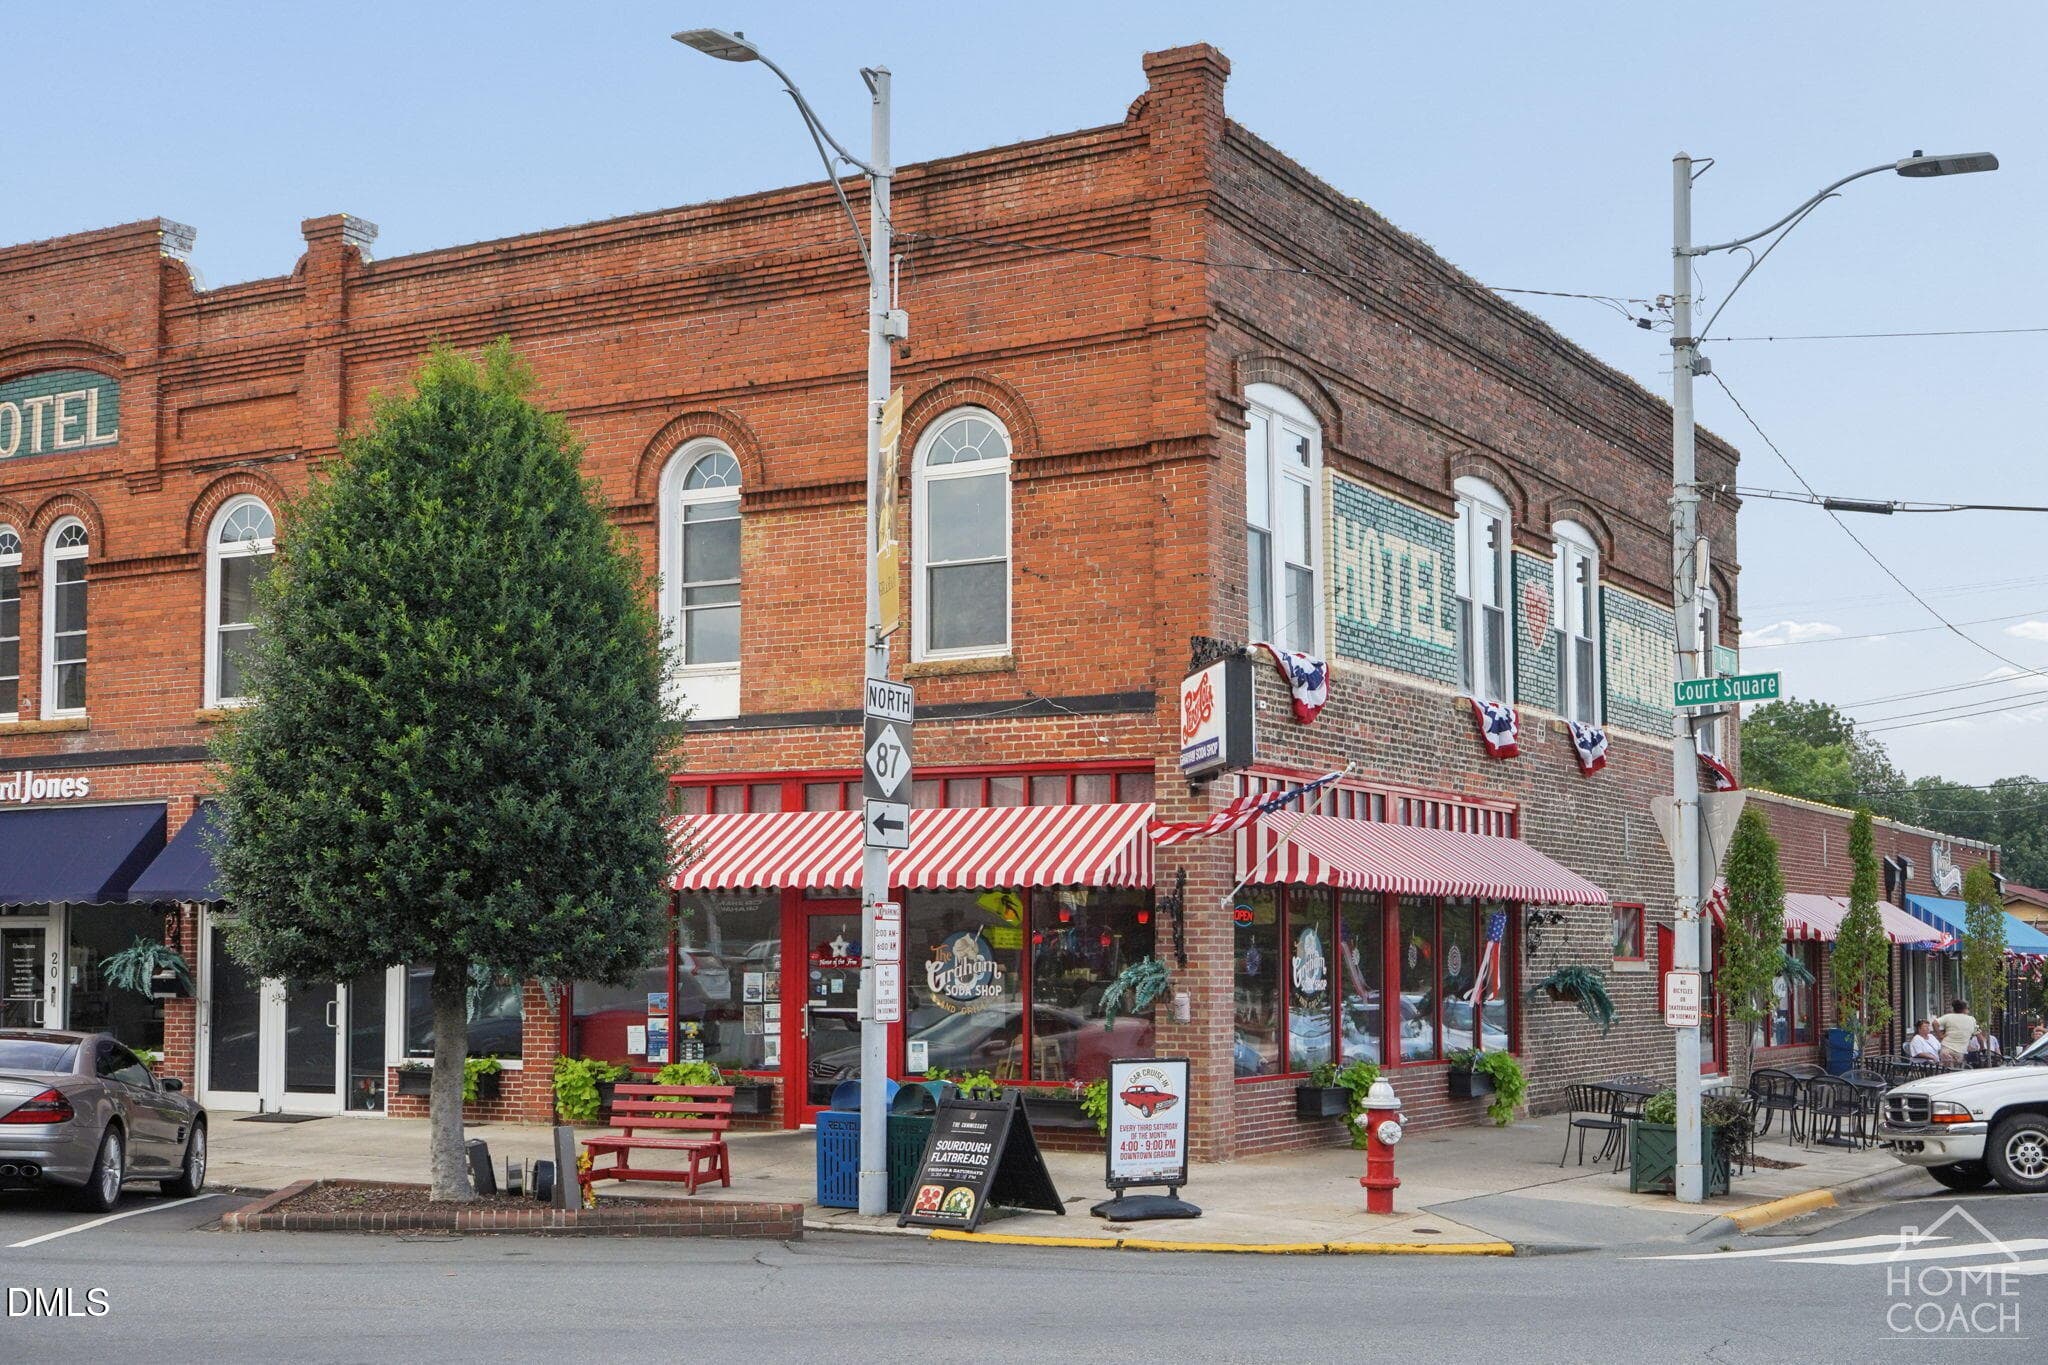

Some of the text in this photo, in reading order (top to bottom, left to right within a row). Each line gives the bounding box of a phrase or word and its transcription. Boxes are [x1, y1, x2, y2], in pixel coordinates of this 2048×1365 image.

[1335, 516, 1453, 650] HOTEL
[1677, 678, 1776, 701] Court Square
[869, 685, 910, 714] NORTH
[876, 742, 901, 778] 87
[1233, 909, 1254, 922] OPEN
[930, 944, 952, 962] The
[925, 955, 1001, 993] Graham
[945, 985, 1002, 996] SODA SHOP
[1130, 1071, 1142, 1084] CAR
[1120, 1124, 1136, 1132] EVERY
[1153, 1122, 1178, 1130] SATURDAY
[935, 1140, 992, 1153] SOURDOUGH
[1120, 1141, 1138, 1151] 4:00
[1145, 1140, 1162, 1150] 9:00
[1165, 1139, 1176, 1149] PM
[930, 1152, 989, 1165] FLATBREADS
[1120, 1152, 1152, 1160] DOWNTOWN
